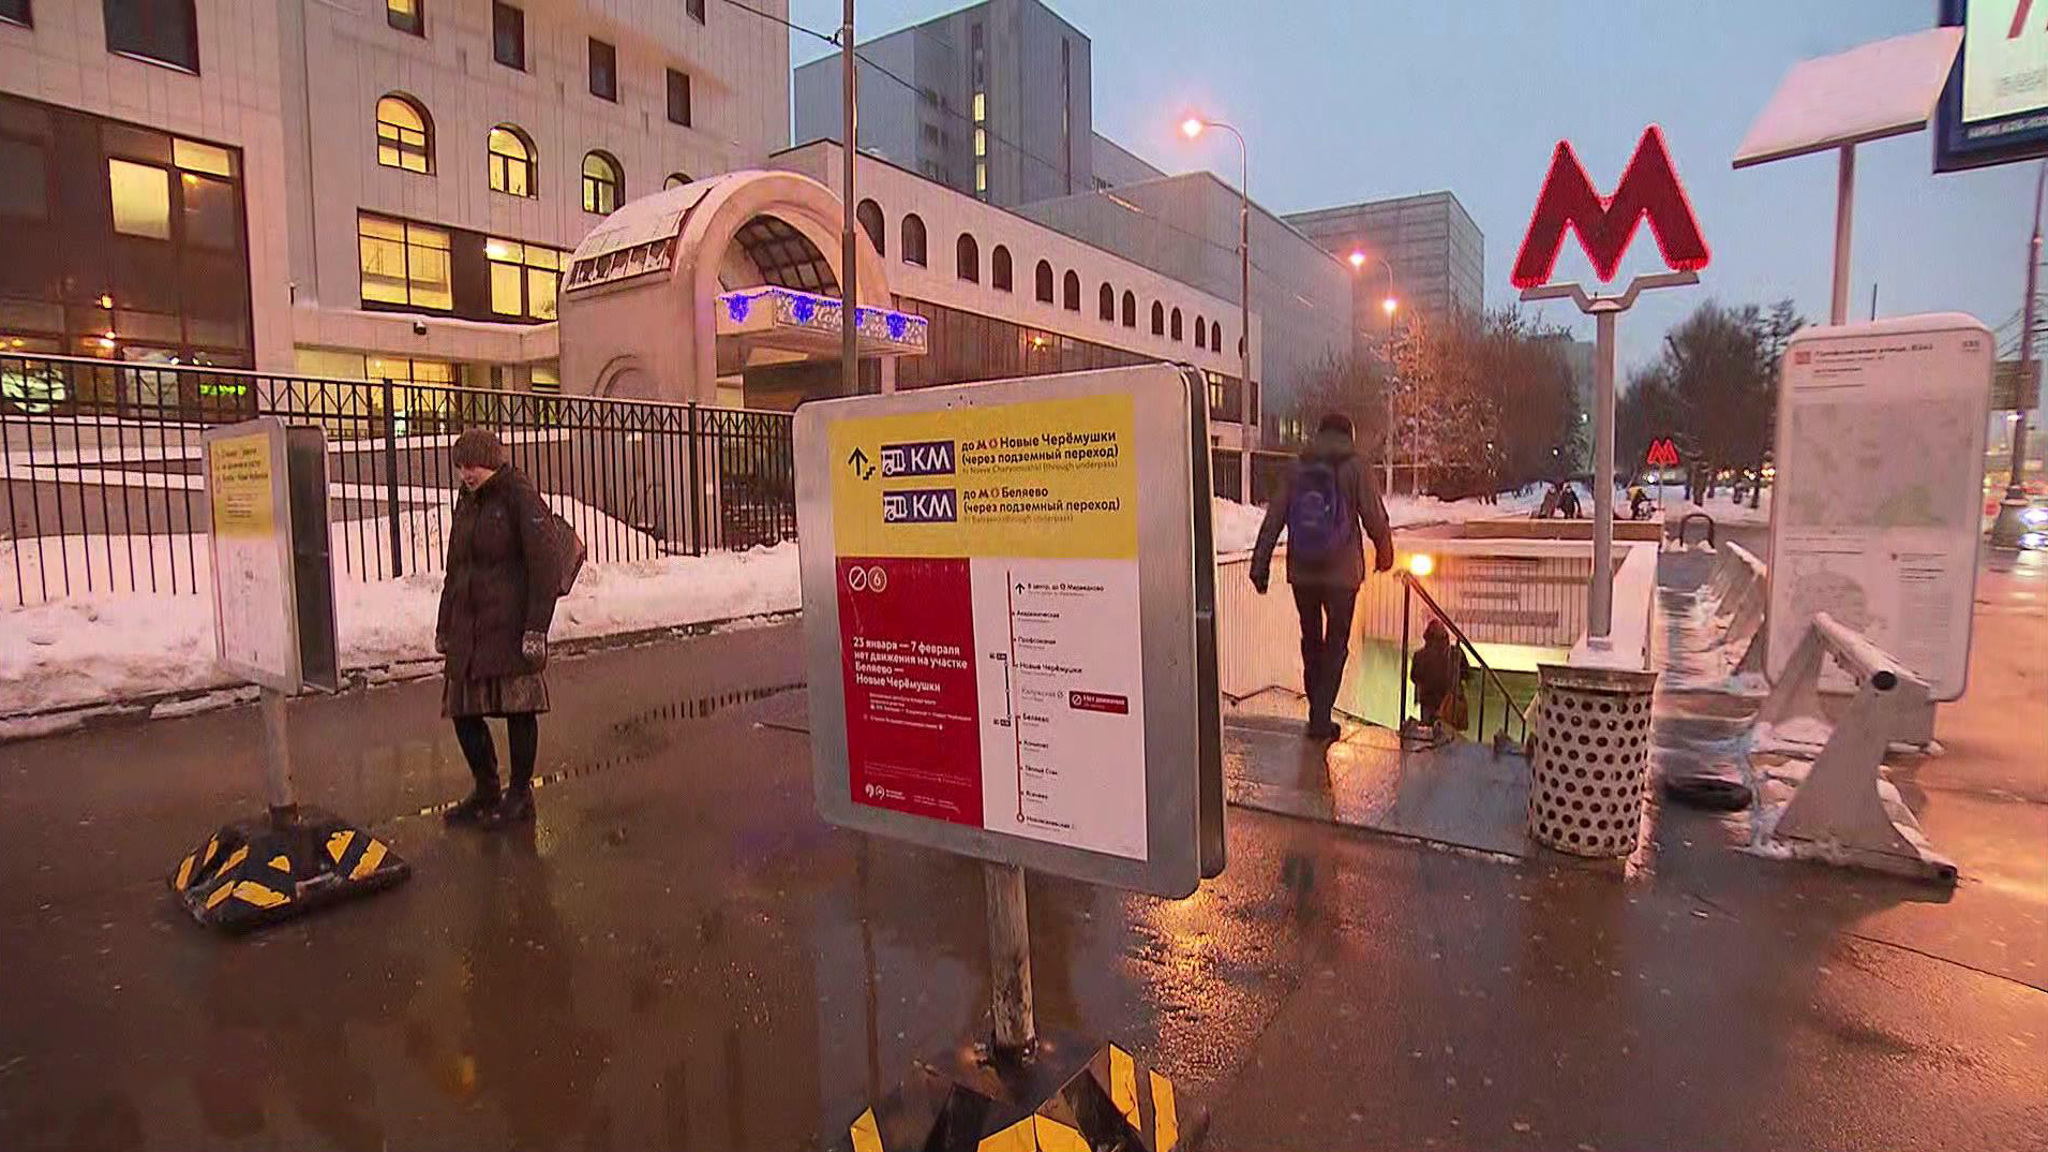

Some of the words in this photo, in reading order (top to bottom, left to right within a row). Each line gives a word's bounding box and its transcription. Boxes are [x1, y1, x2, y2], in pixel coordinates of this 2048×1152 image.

[962, 442, 975, 452] до
[1000, 437, 1039, 448] Новые
[1042, 431, 1116, 447] Черёмушки
[962, 453, 995, 466] (через
[998, 448, 1062, 463] подземный
[1065, 444, 1119, 461] переход)
[963, 489, 976, 500] до
[1001, 486, 1049, 498] Беляево
[963, 503, 997, 515] (через
[1000, 499, 1063, 513] подземный
[1066, 498, 1120, 512] переход)
[853, 637, 864, 648] 23
[866, 640, 897, 652] января
[911, 641, 917, 652] 7
[918, 641, 960, 656] февраля
[854, 651, 869, 660] нет
[870, 652, 916, 664] движения
[917, 656, 929, 666] на
[930, 656, 968, 670] участке
[855, 660, 892, 674] Беляево
[856, 673, 886, 686] Новые
[887, 676, 941, 693] Черёмушки
